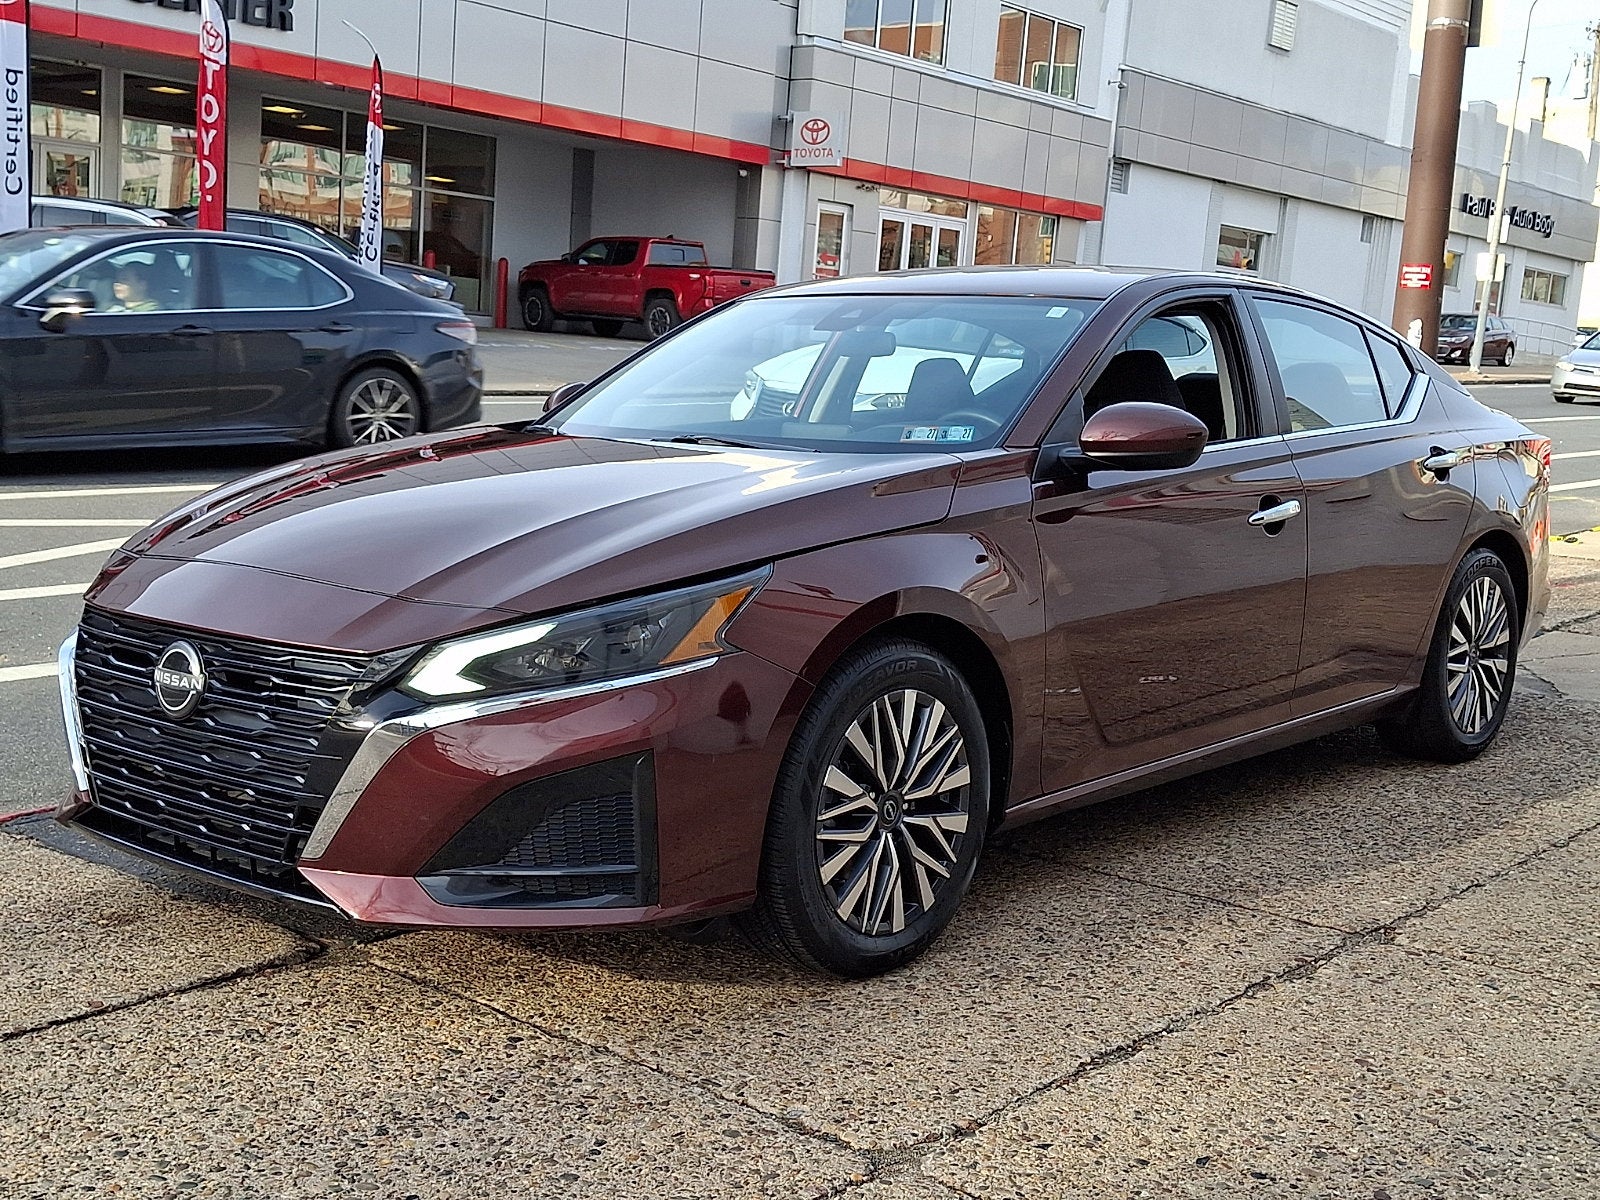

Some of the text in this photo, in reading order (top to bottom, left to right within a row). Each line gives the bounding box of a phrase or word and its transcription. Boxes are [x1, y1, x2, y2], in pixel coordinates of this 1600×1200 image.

[794, 148, 833, 158] TOYOTA
[1464, 193, 1488, 217] Paul
[1512, 206, 1534, 229] Auto
[1535, 211, 1556, 239] Body
[927, 428, 936, 439] 27
[962, 428, 972, 439] 27
[1462, 558, 1497, 587] COOPER
[154, 669, 203, 690] NISSAN
